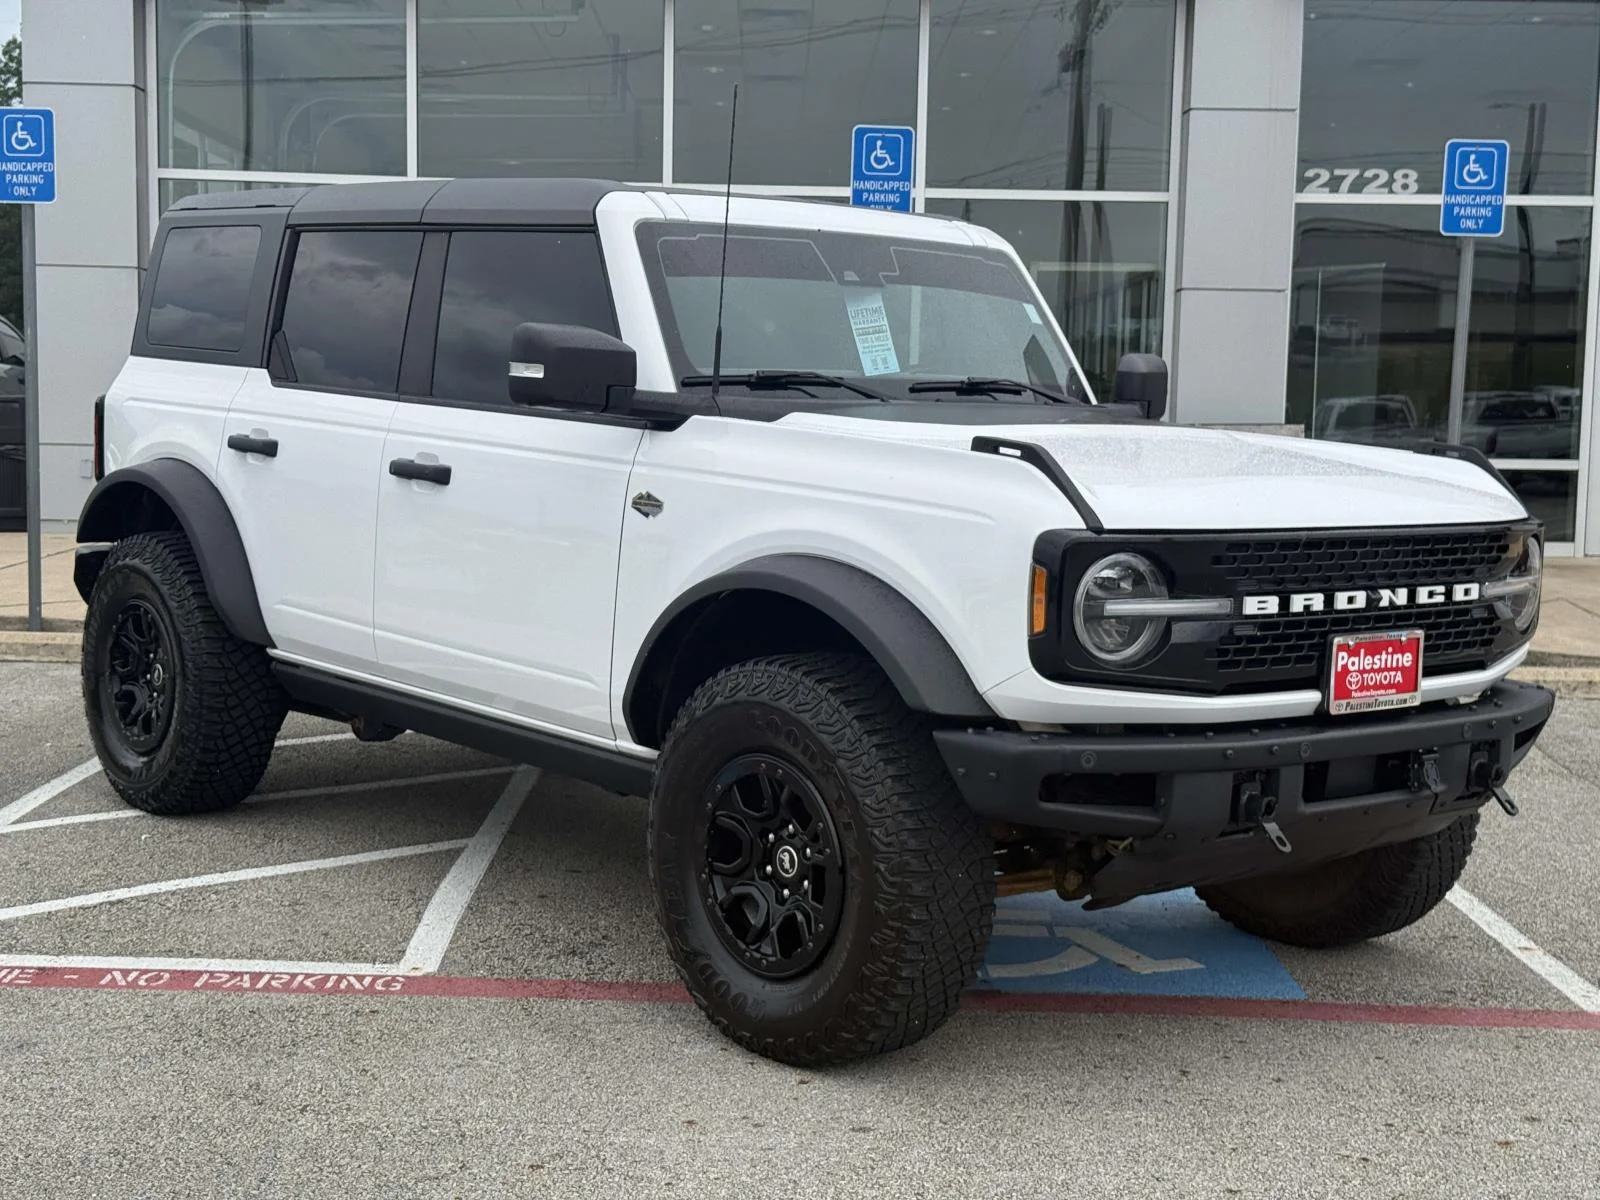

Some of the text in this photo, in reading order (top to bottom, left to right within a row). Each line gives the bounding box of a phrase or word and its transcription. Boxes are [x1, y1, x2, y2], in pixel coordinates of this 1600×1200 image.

[0, 162, 53, 172] ANDICAPPED
[6, 174, 44, 184] PARKING
[1303, 168, 1419, 195] 2728
[13, 186, 37, 196] ONLY
[853, 181, 910, 191] HANDICAPPED
[862, 192, 900, 203] PARKING
[1444, 194, 1503, 205] HANDICAPPED
[1453, 206, 1492, 217] PARKING
[1460, 218, 1484, 230] ONLY
[849, 306, 885, 319] LIFETIME
[1242, 583, 1480, 615] BRONCO
[1337, 646, 1412, 672] Palestine
[1362, 670, 1403, 687] TOYOTA
[99, 970, 170, 987] NO
[193, 972, 405, 992] PARKING
